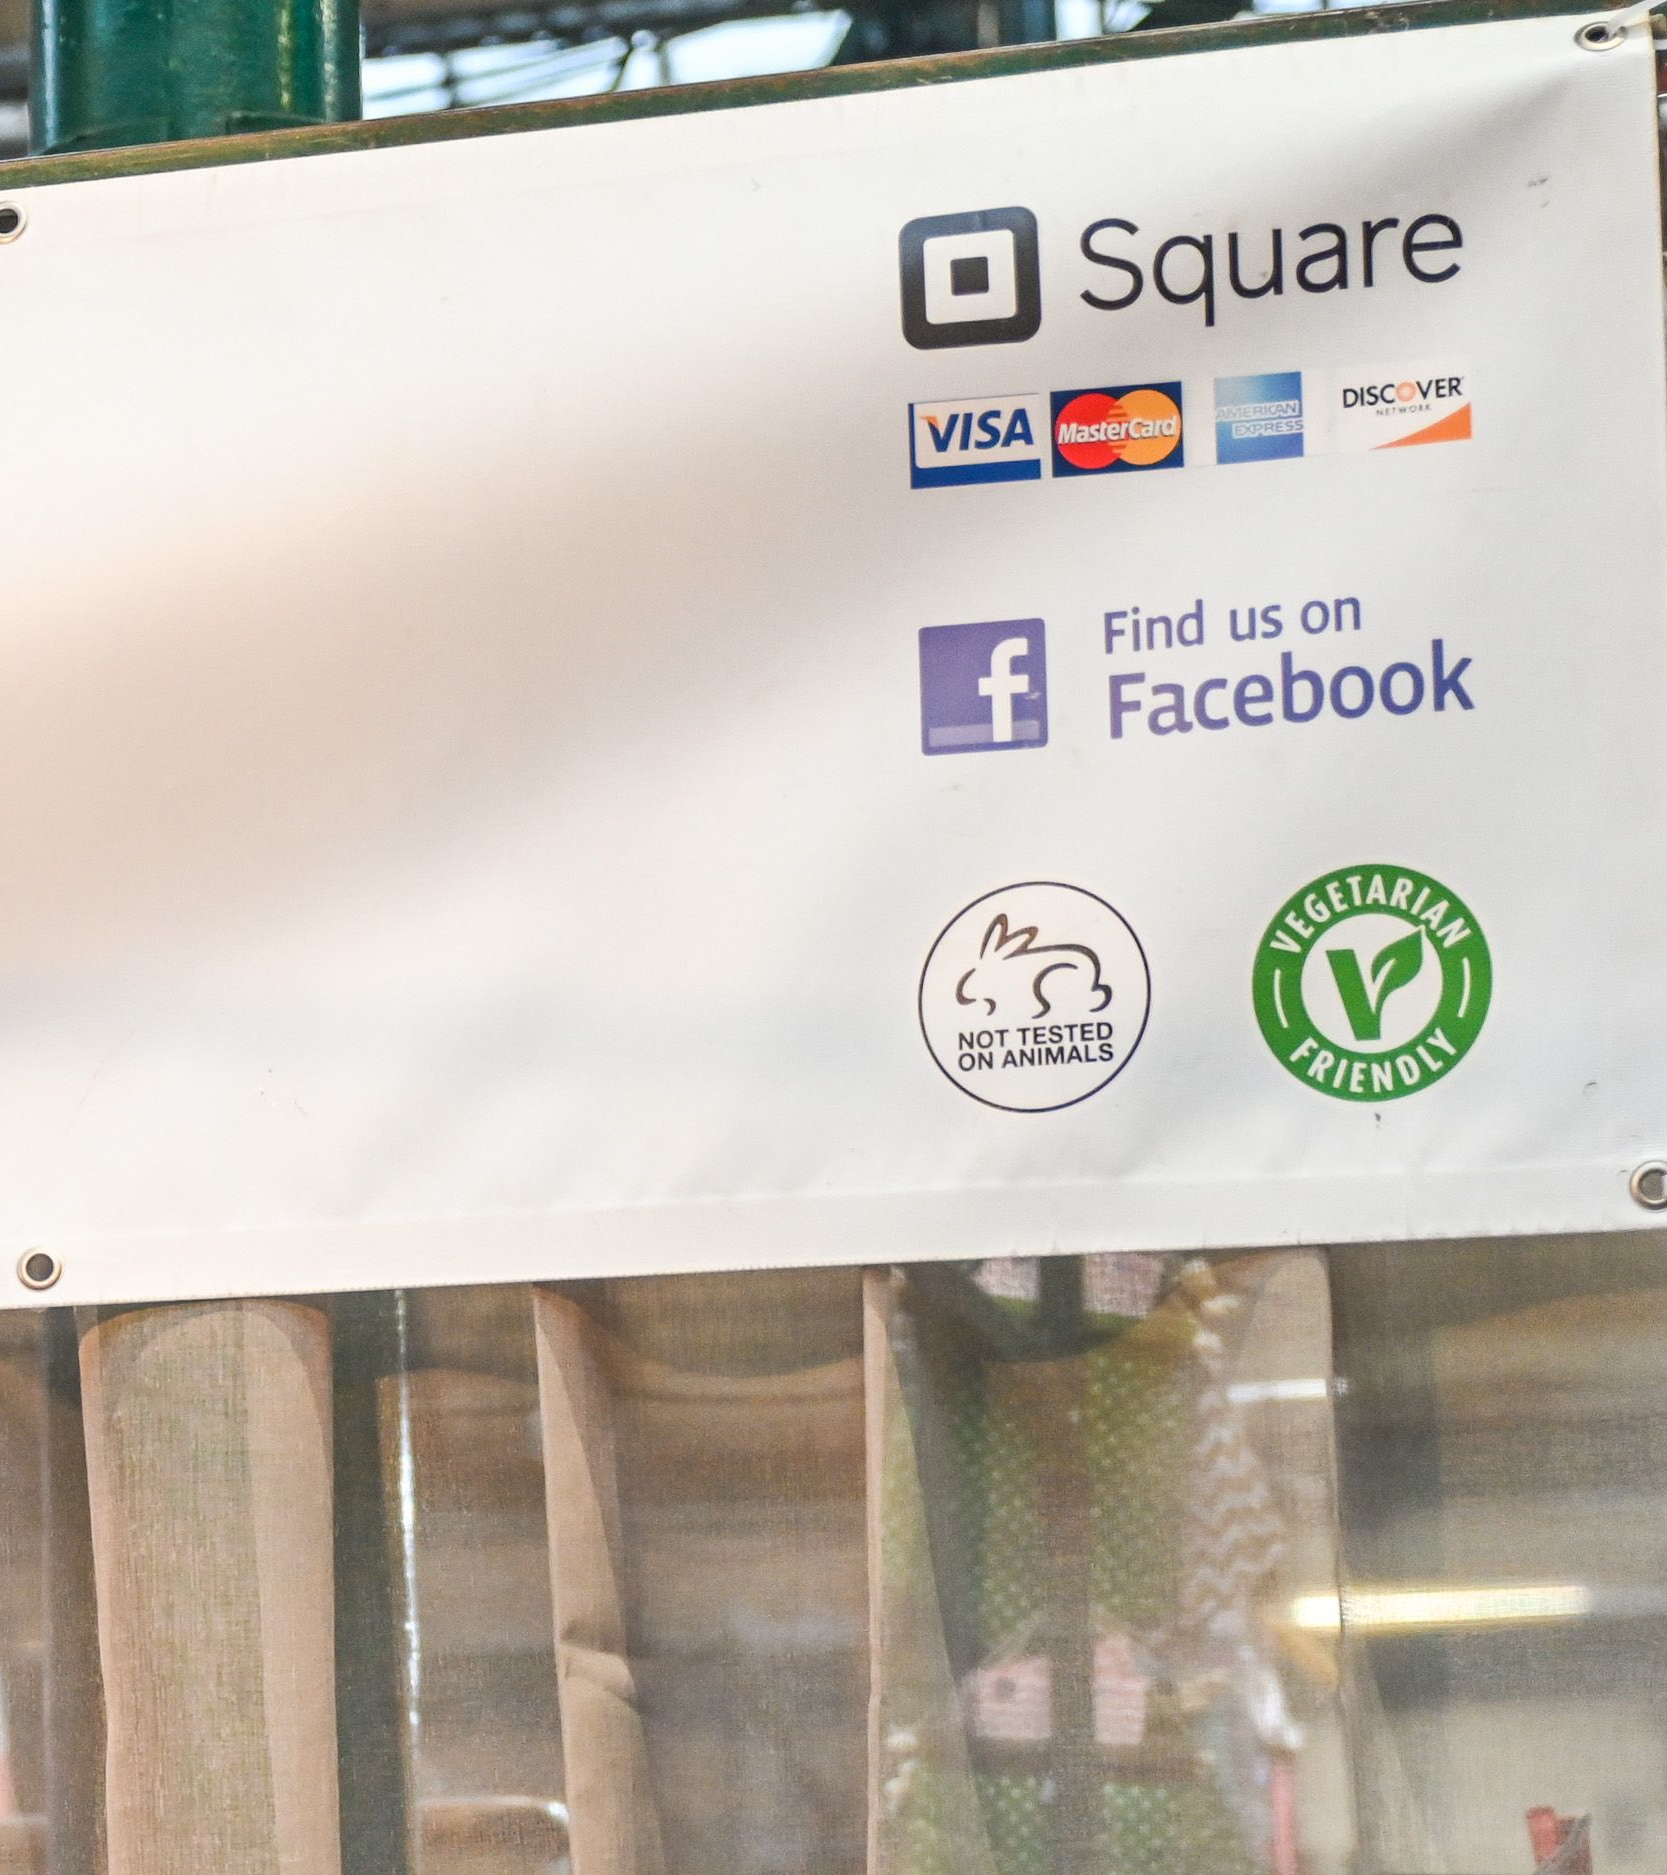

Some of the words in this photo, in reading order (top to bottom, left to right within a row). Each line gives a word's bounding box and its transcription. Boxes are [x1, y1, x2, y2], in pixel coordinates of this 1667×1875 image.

[1079, 209, 1464, 328] Square
[1342, 377, 1463, 409] DISCOVER
[1376, 404, 1432, 416] NETWORK
[921, 407, 1034, 454] VISA
[1056, 414, 1177, 445] MasterCard
[1216, 402, 1298, 420] AMERICAN
[1234, 420, 1304, 437] EXPRESS
[1103, 600, 1204, 655] Find
[1229, 602, 1283, 643] us
[1300, 596, 1362, 634] on
[1109, 639, 1475, 740] Facebook
[1269, 874, 1472, 957] VEGETARIAN
[958, 1027, 1011, 1049] NOT
[1017, 1021, 1114, 1046] TESTED
[958, 1048, 995, 1072] ON
[1001, 1043, 1114, 1068] ANIMALS
[1289, 1027, 1459, 1094] FRIENDLY
